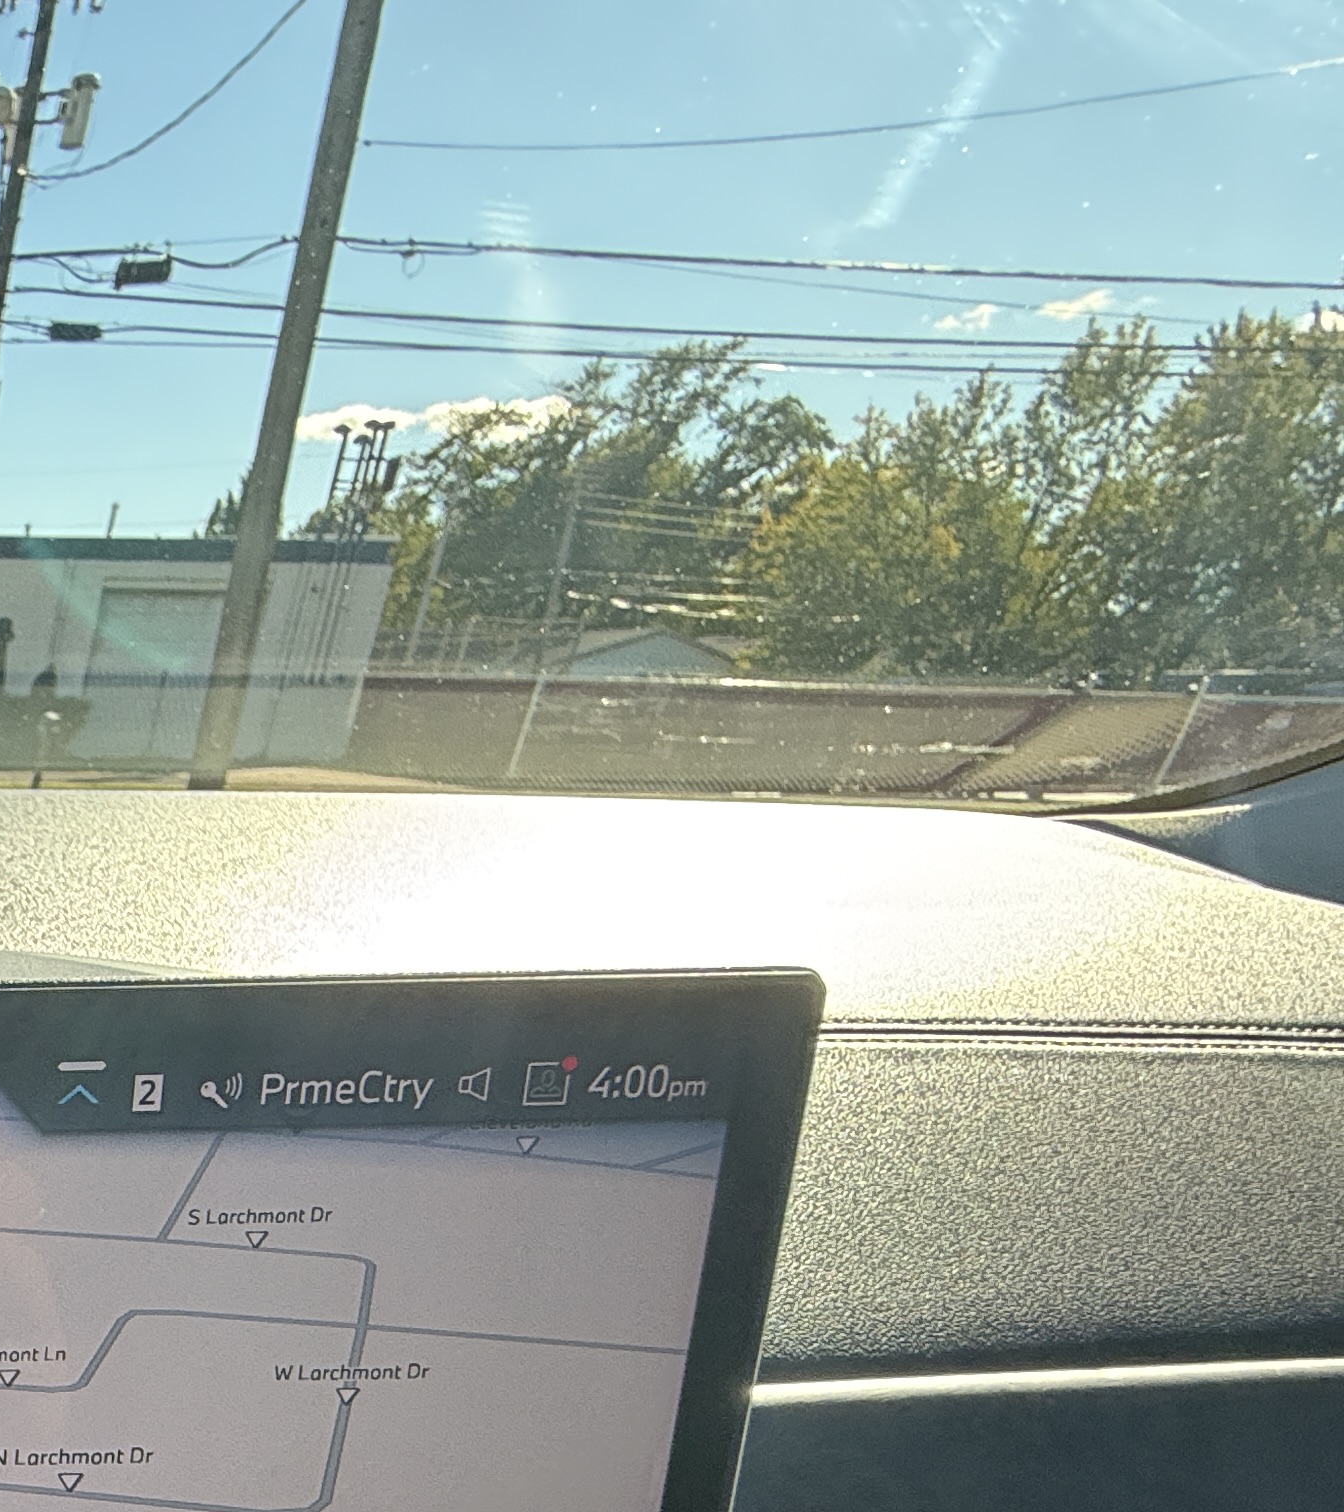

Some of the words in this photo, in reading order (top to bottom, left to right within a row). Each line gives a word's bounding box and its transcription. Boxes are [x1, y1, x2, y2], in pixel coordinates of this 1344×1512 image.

[258, 1071, 434, 1110] PrmeCtry
[587, 1064, 708, 1101] 4:00pm
[187, 1208, 201, 1226] S
[205, 1206, 307, 1226] Larchmont
[311, 1206, 334, 1225] Dr
[44, 1346, 67, 1364] Ln
[273, 1364, 293, 1382] W
[298, 1362, 402, 1382] Larchmont
[406, 1362, 431, 1381] Dr
[10, 1447, 125, 1468] Larchmont
[129, 1447, 155, 1466] Dr
